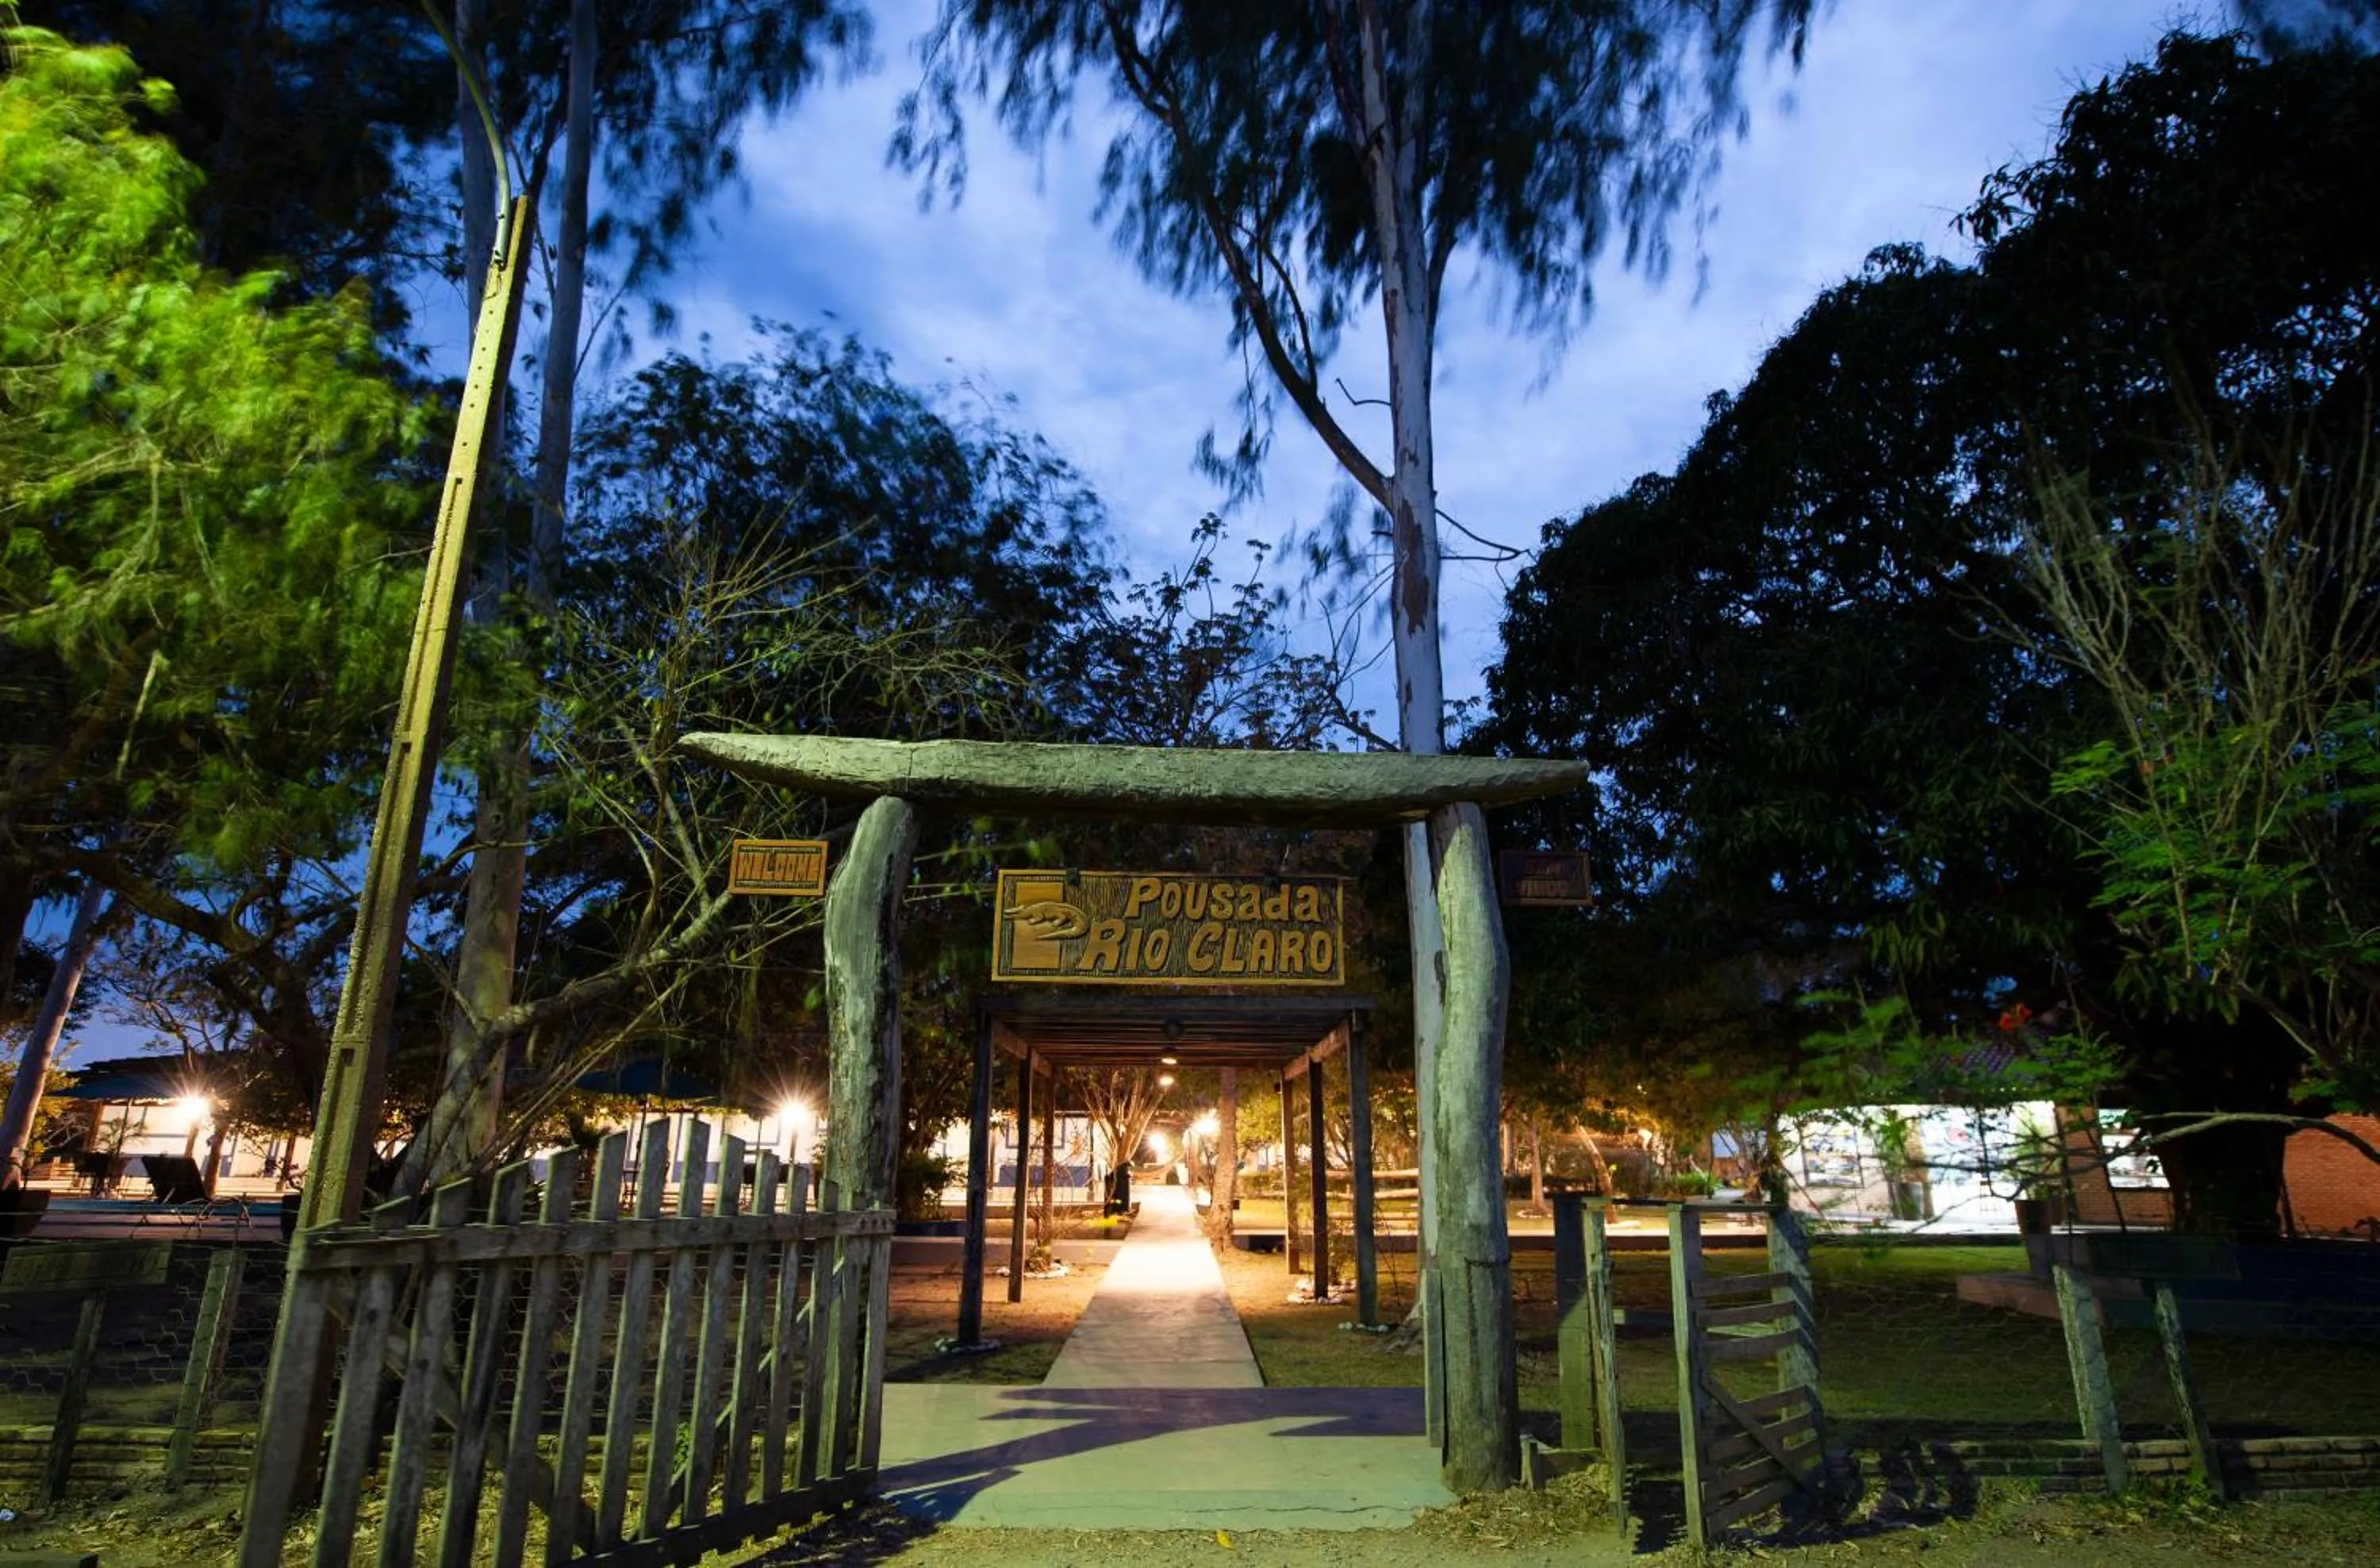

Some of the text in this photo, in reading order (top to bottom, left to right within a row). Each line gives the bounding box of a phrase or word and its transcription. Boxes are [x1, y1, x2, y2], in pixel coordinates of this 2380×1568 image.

[737, 851, 821, 882] WELCOME
[1077, 918, 1333, 974] RIO CLARO
